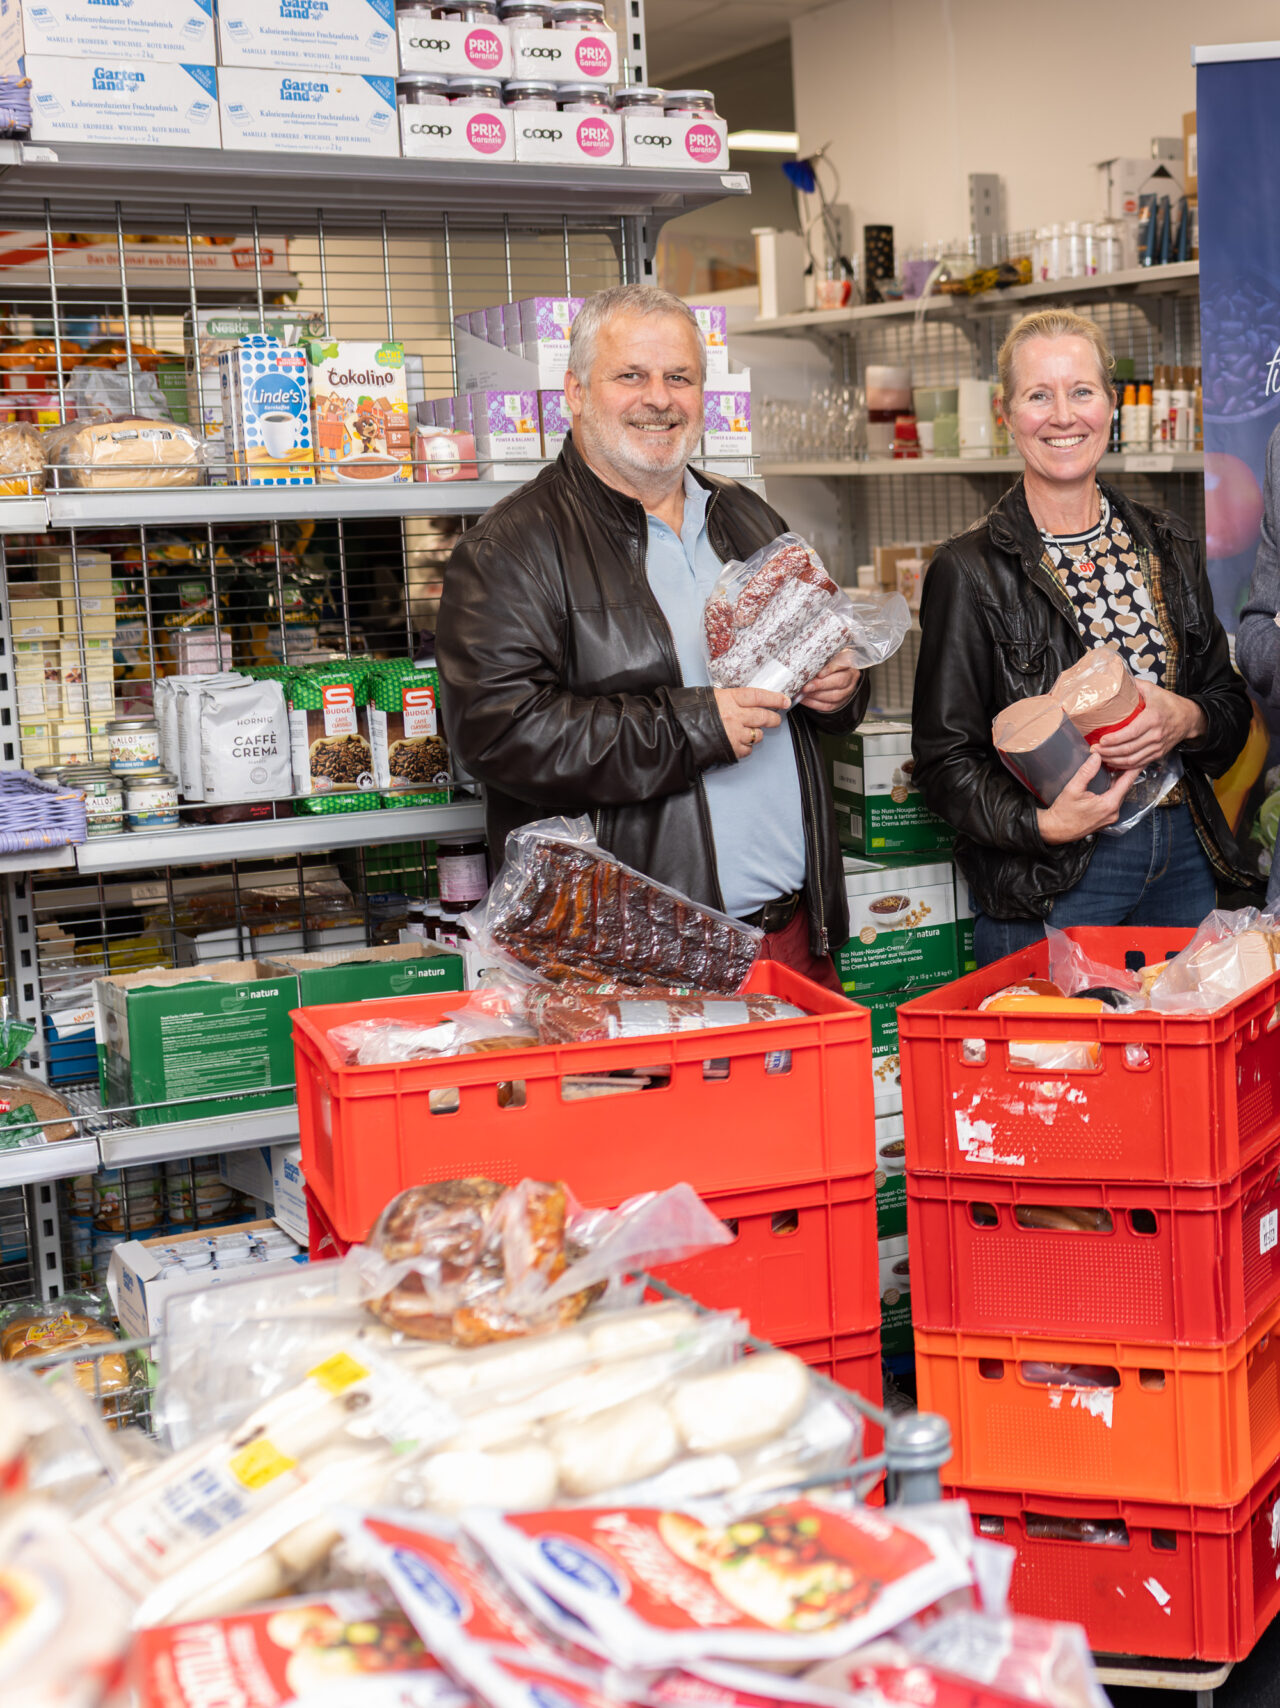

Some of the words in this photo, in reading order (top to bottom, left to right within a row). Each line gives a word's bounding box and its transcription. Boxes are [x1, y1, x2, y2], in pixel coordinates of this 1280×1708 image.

[280, 6, 310, 20] land
[409, 37, 450, 52] coop
[469, 51, 499, 61] Garantie
[521, 47, 562, 61] coop
[579, 60, 608, 68] Garantie
[94, 67, 145, 82] Garten
[92, 78, 125, 91] land
[282, 78, 330, 93] Garten
[280, 88, 310, 102] land
[410, 122, 452, 139] coop
[523, 128, 563, 142] coop
[471, 136, 502, 145] Garantie
[581, 140, 610, 148] Garantie
[634, 134, 672, 148] coop
[689, 146, 718, 155] Garantie
[404, 708, 434, 717] BUDGET
[236, 716, 274, 726] HORNIG
[116, 736, 137, 744] ALLOS
[234, 731, 277, 746] CAFFÈ
[232, 747, 278, 758] CREMA
[92, 797, 113, 806] ALLOS
[916, 928, 940, 938] natura
[850, 956, 863, 964] Pâte
[868, 953, 887, 961] tartiner
[418, 968, 446, 978] natura
[250, 988, 279, 999] natura
[872, 1045, 888, 1054] natu
